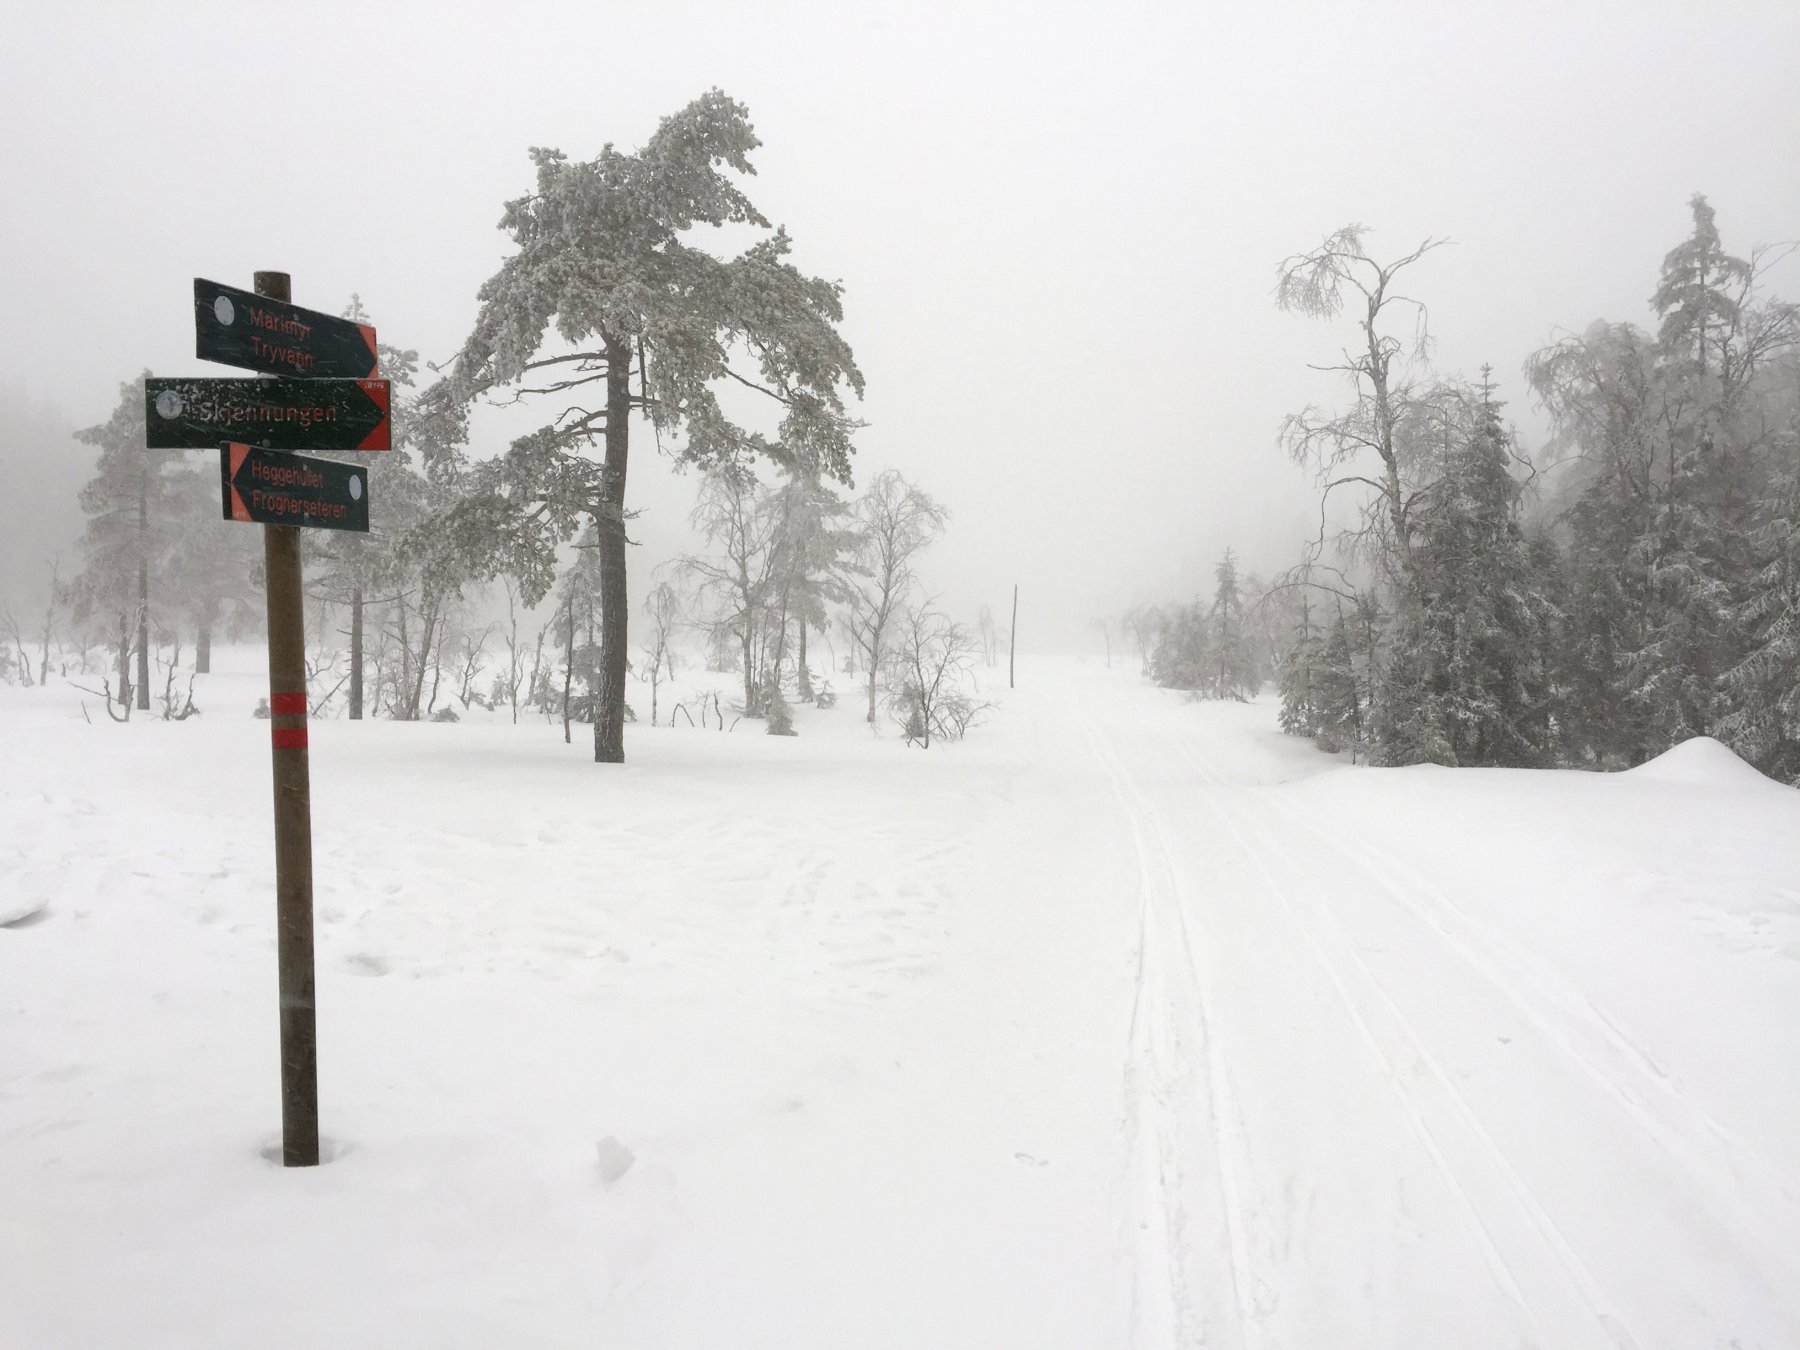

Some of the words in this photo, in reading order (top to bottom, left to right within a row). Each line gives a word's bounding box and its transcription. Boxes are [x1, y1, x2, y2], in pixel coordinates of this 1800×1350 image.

[249, 306, 311, 341] Marimyr
[251, 336, 313, 369] Tryvann
[200, 400, 337, 427] Skjennungen
[252, 489, 346, 518] Frognerseteren
